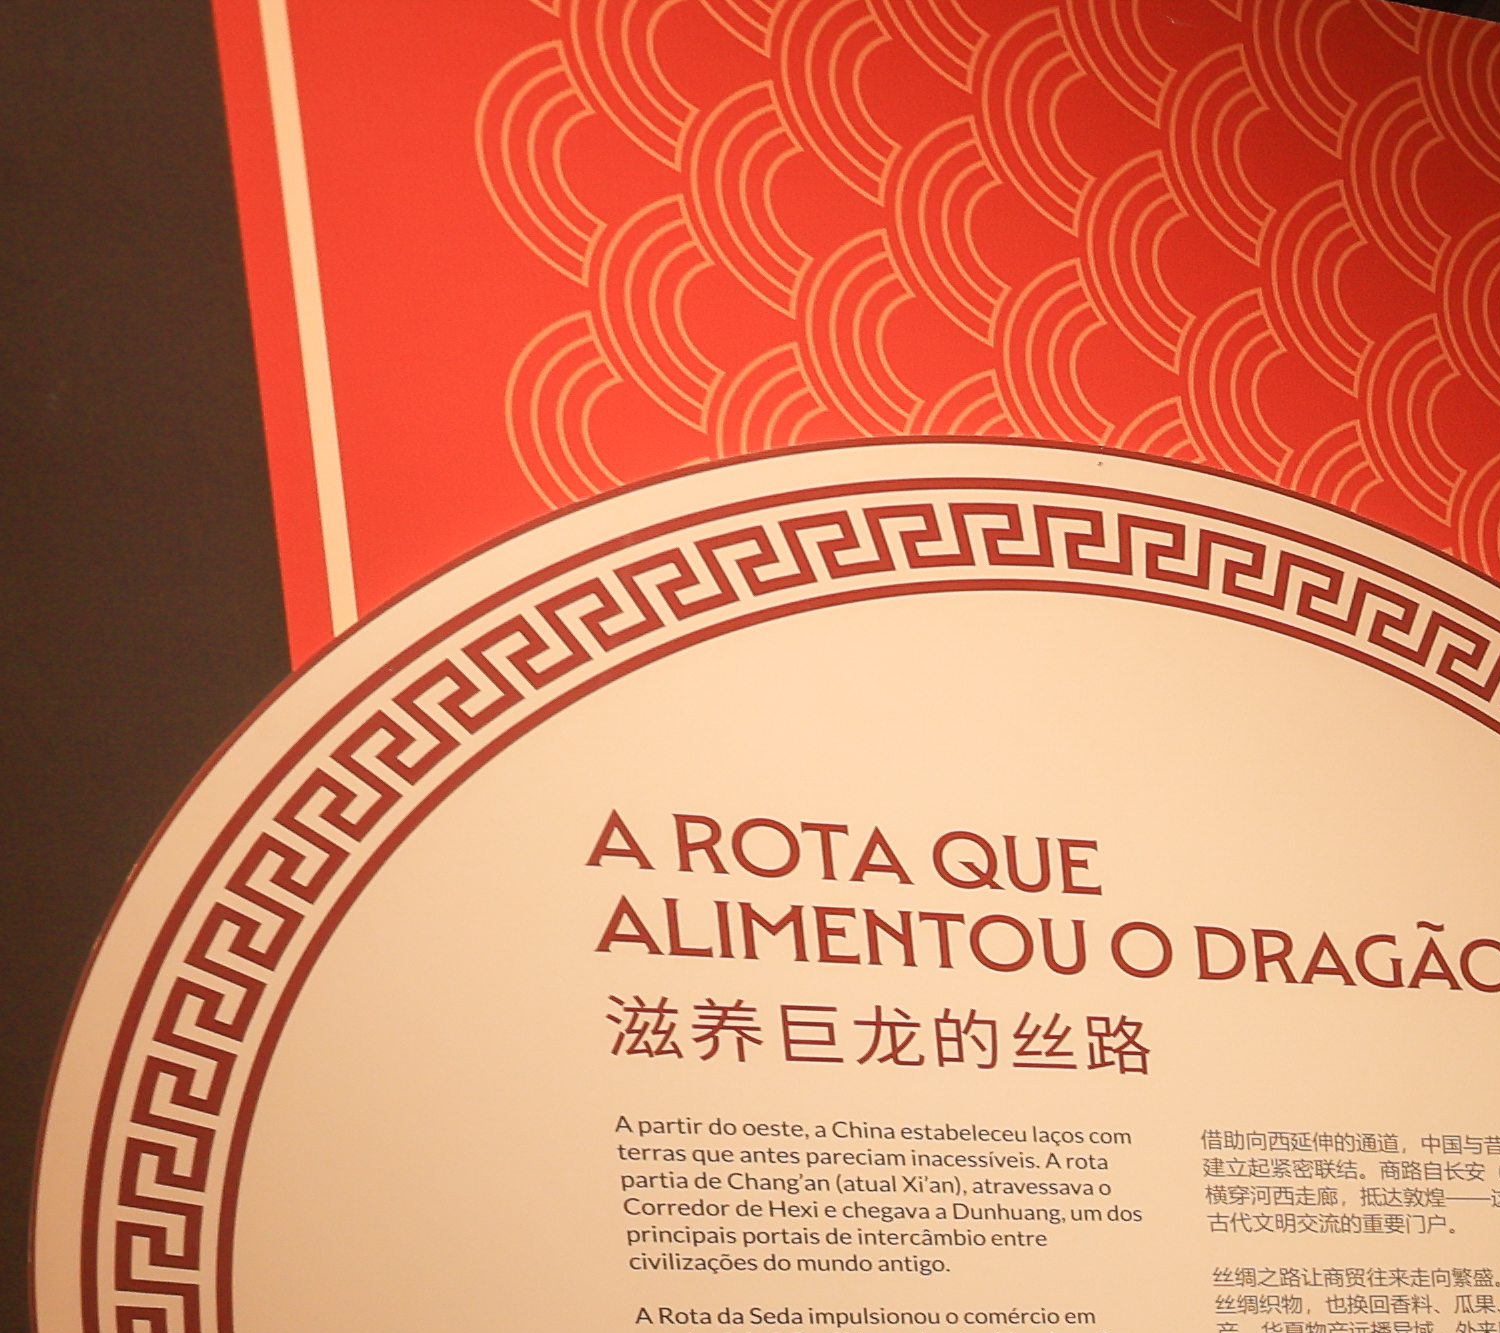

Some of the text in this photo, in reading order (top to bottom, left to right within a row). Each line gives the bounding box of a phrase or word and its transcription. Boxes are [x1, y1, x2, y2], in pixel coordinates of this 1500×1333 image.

[585, 809, 1102, 896] A ROTA QUE
[594, 895, 1086, 975] ALIMENTOU
[1111, 922, 1173, 978] O
[606, 993, 1151, 1076] 滋养巨龙的丝路
[615, 1116, 1131, 1146] A partir do oeste, a China estabeleceu laços com
[617, 1144, 1108, 1170] terras que antes pareciam inacessíveis. A rota
[621, 1171, 688, 1191] partia
[694, 1172, 722, 1189] de
[836, 1174, 896, 1194] (atual
[972, 1179, 1094, 1195] atravessava
[1099, 1184, 1111, 1195] o
[624, 1198, 1142, 1224] Corredor de Hexi e chegava a Dunhuang, um dos
[627, 1226, 1047, 1248] principais portais de intercâmbio entre
[630, 1253, 950, 1276] civilizações do mundo antigo.
